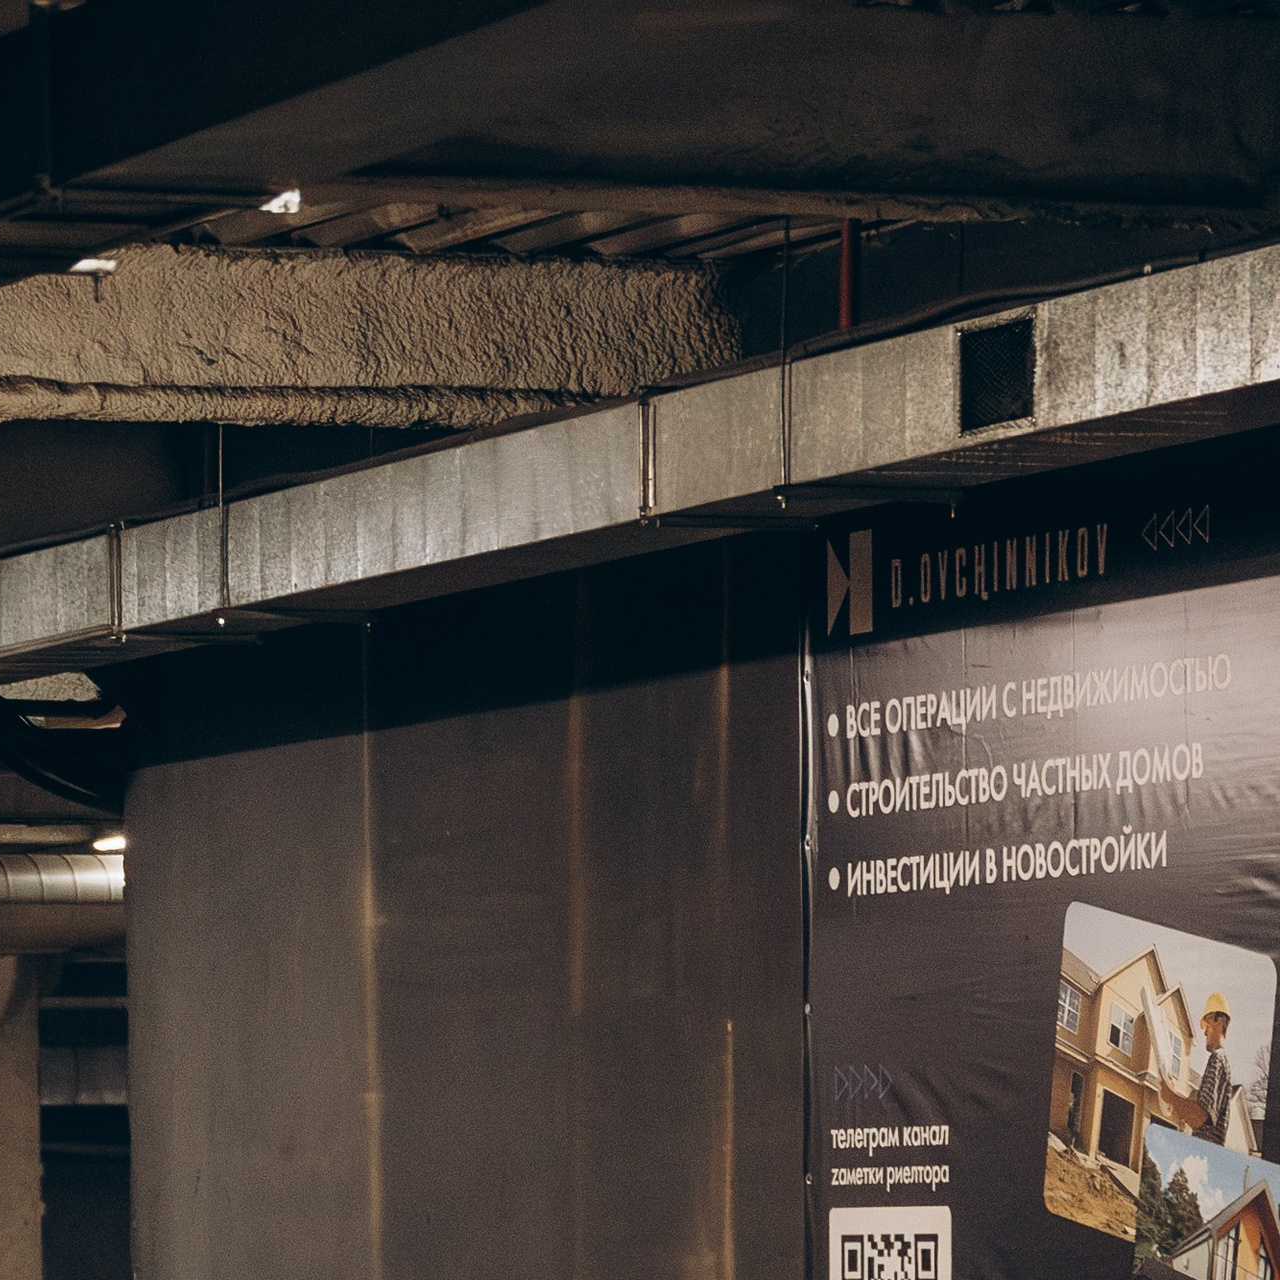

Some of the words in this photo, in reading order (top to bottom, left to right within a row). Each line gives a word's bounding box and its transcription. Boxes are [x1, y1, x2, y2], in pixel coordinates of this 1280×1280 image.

[846, 701, 881, 739] ВСЕ
[885, 684, 997, 735] ОПЕРАЦИИ
[1003, 682, 1017, 718] С
[1022, 653, 1232, 719] НЕДВИЖИМОСТЬЮ
[846, 765, 1008, 818] СТРОИТЕЛЬСТВО
[1013, 752, 1111, 798] ЧАСТНЫХ
[1116, 742, 1203, 795] ДОМОВ
[847, 850, 980, 898] ИНВЕСТИЦИИ
[985, 848, 998, 884] В
[1002, 824, 1167, 882] НОВОСТРОЙКИ
[830, 1127, 900, 1157] телеграм
[903, 1125, 949, 1146] канал
[886, 1165, 950, 1192] риелтора
